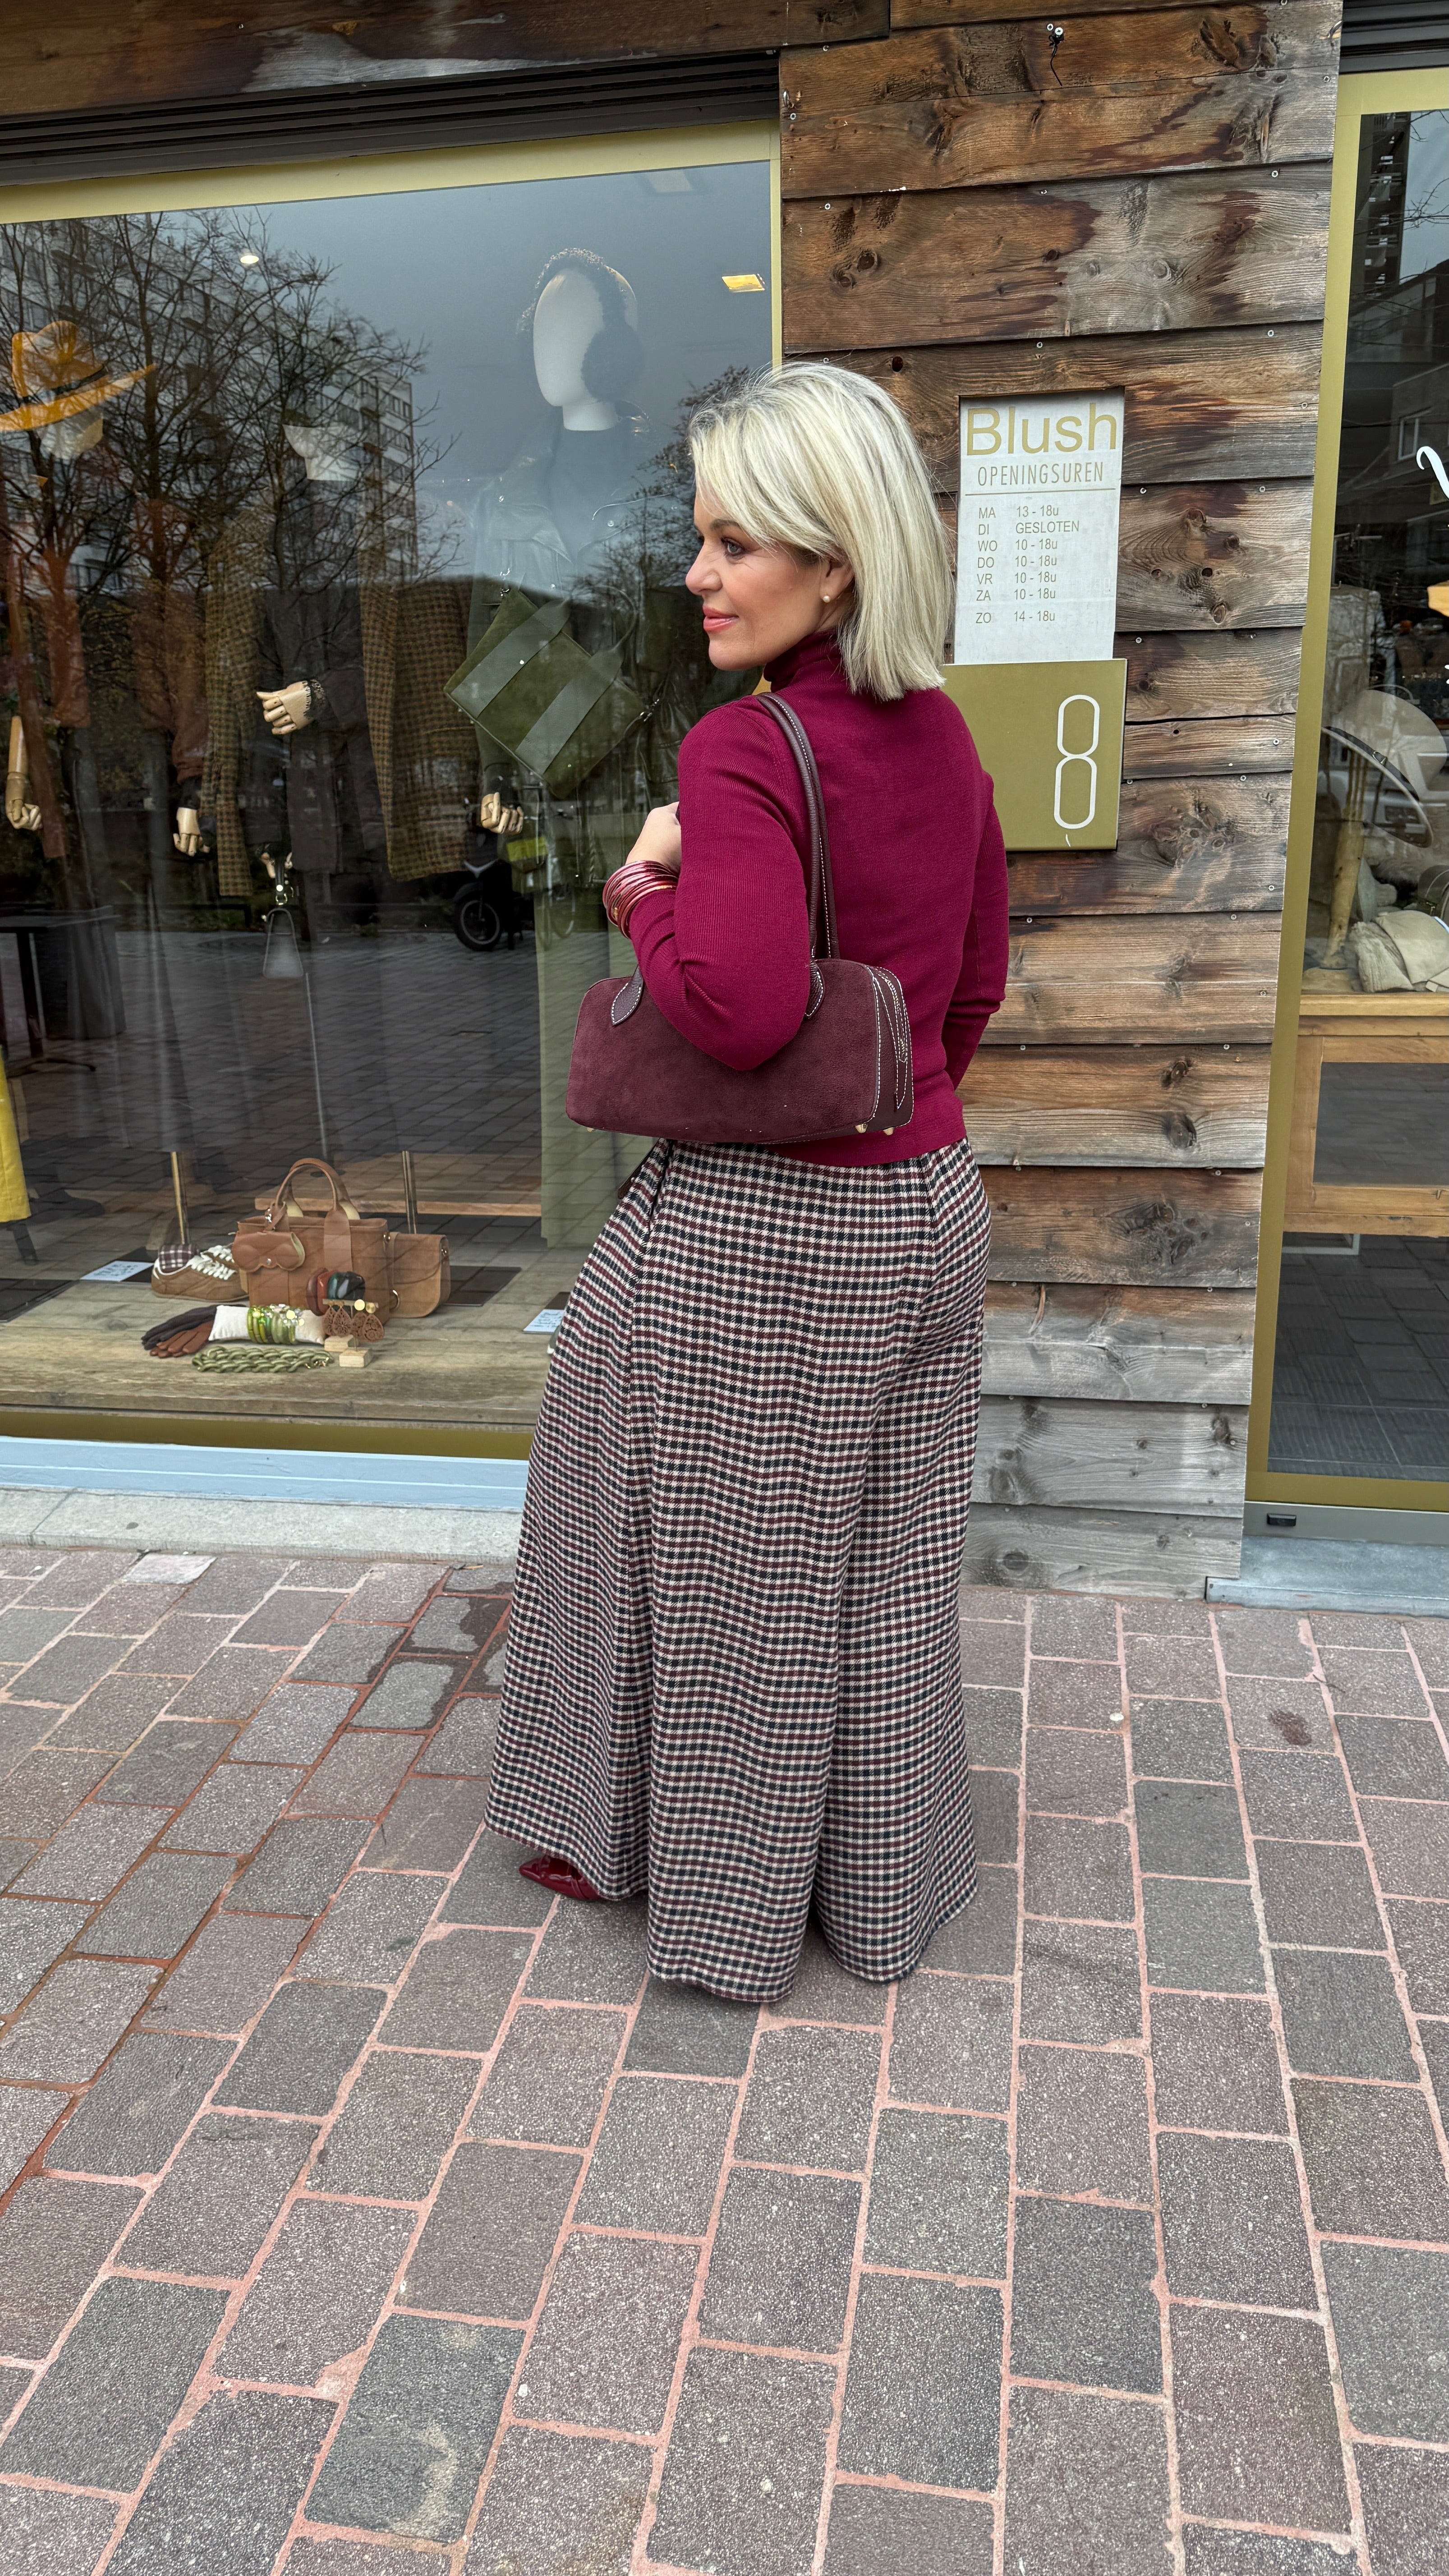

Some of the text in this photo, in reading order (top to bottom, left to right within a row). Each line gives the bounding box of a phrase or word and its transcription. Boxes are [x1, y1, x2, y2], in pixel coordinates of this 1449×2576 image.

[966, 403, 1117, 455] Blush
[978, 462, 1103, 486] OPENINGSUREN
[979, 506, 996, 519] MA
[1017, 506, 1029, 518] 13
[1040, 505, 1059, 516] 18u
[978, 520, 1079, 535] DI GESLOTEN
[978, 540, 998, 552] WO
[1015, 539, 1027, 551] 10
[1039, 538, 1058, 550] 18u
[977, 557, 994, 568] DO
[1015, 555, 1027, 567] 10
[1039, 555, 1057, 567] 18u
[976, 573, 993, 585] VR
[1015, 572, 1026, 584] 10
[1038, 571, 1057, 583] 18u
[976, 589, 991, 601] ZA
[1014, 589, 1026, 600] 10
[1037, 588, 1056, 599] 18u
[975, 612, 992, 624] ZO
[1014, 611, 1026, 622] 14
[1037, 610, 1055, 621] 18u
[1054, 695, 1100, 829] 8
